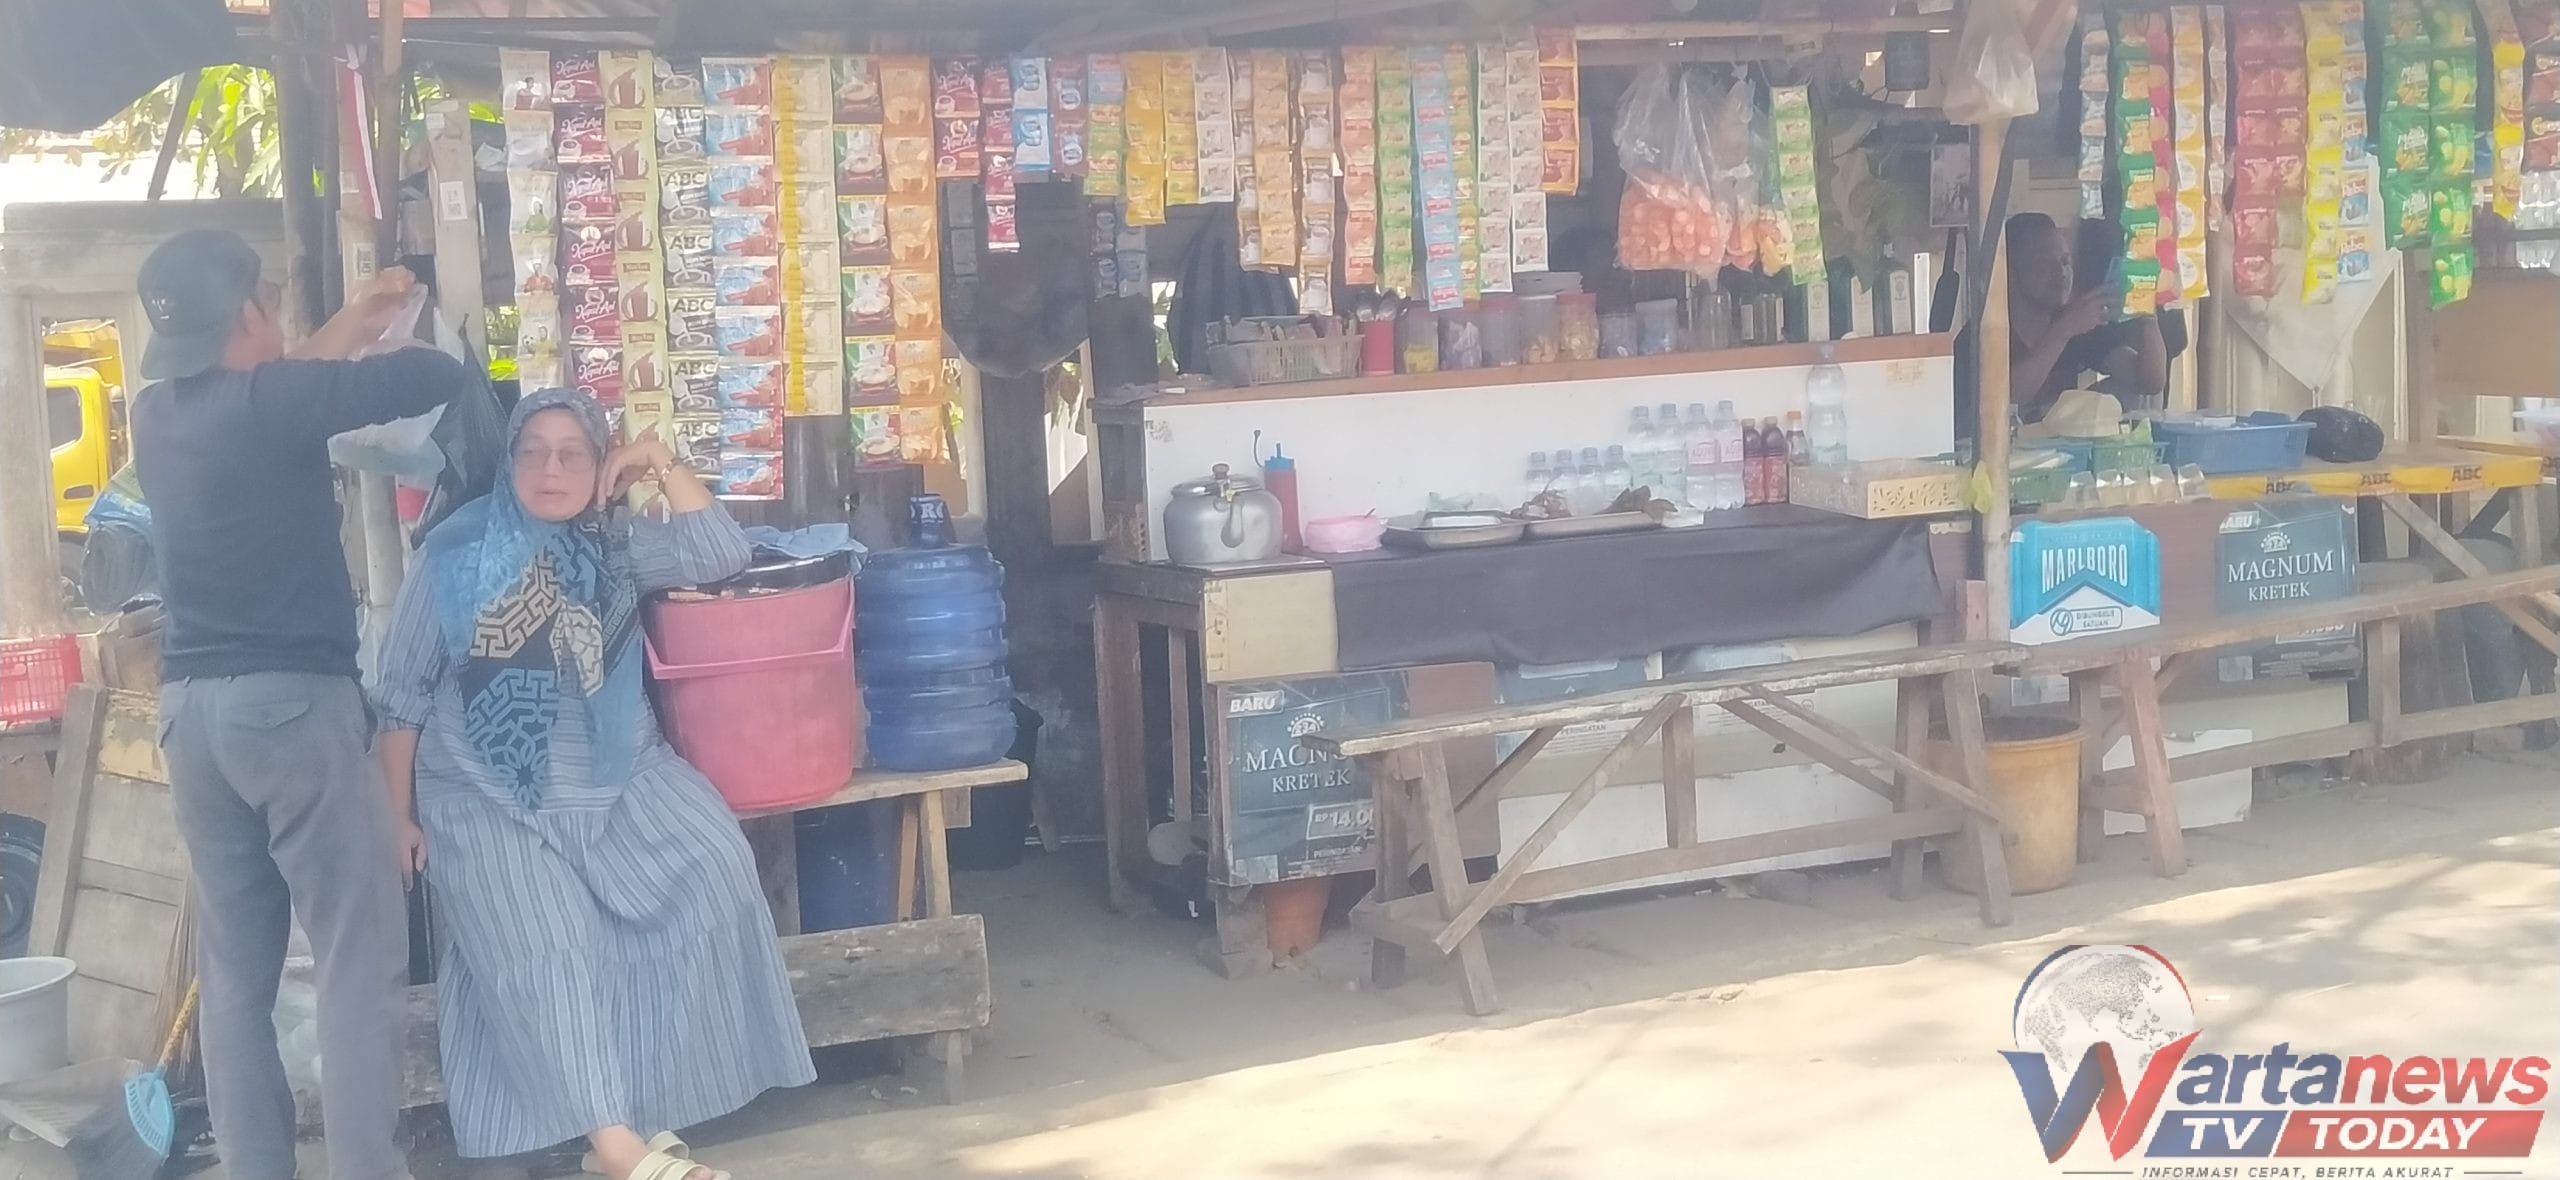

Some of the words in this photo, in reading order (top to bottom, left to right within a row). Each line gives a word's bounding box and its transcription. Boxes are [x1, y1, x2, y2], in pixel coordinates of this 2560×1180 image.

[664, 171, 707, 187] ABC
[668, 235, 711, 250] ABC
[672, 298, 714, 313] ABC
[674, 361, 717, 376] ABC
[677, 423, 720, 437] ABC
[2361, 472, 2391, 486] ABC
[2451, 464, 2483, 482] ABC
[2042, 543, 2128, 594] MARLBORO
[2227, 550, 2334, 583] MAGNUM
[2248, 581, 2311, 602] KRETEK
[1230, 696, 1276, 713] BARU
[1272, 767, 1352, 793] KRETEK
